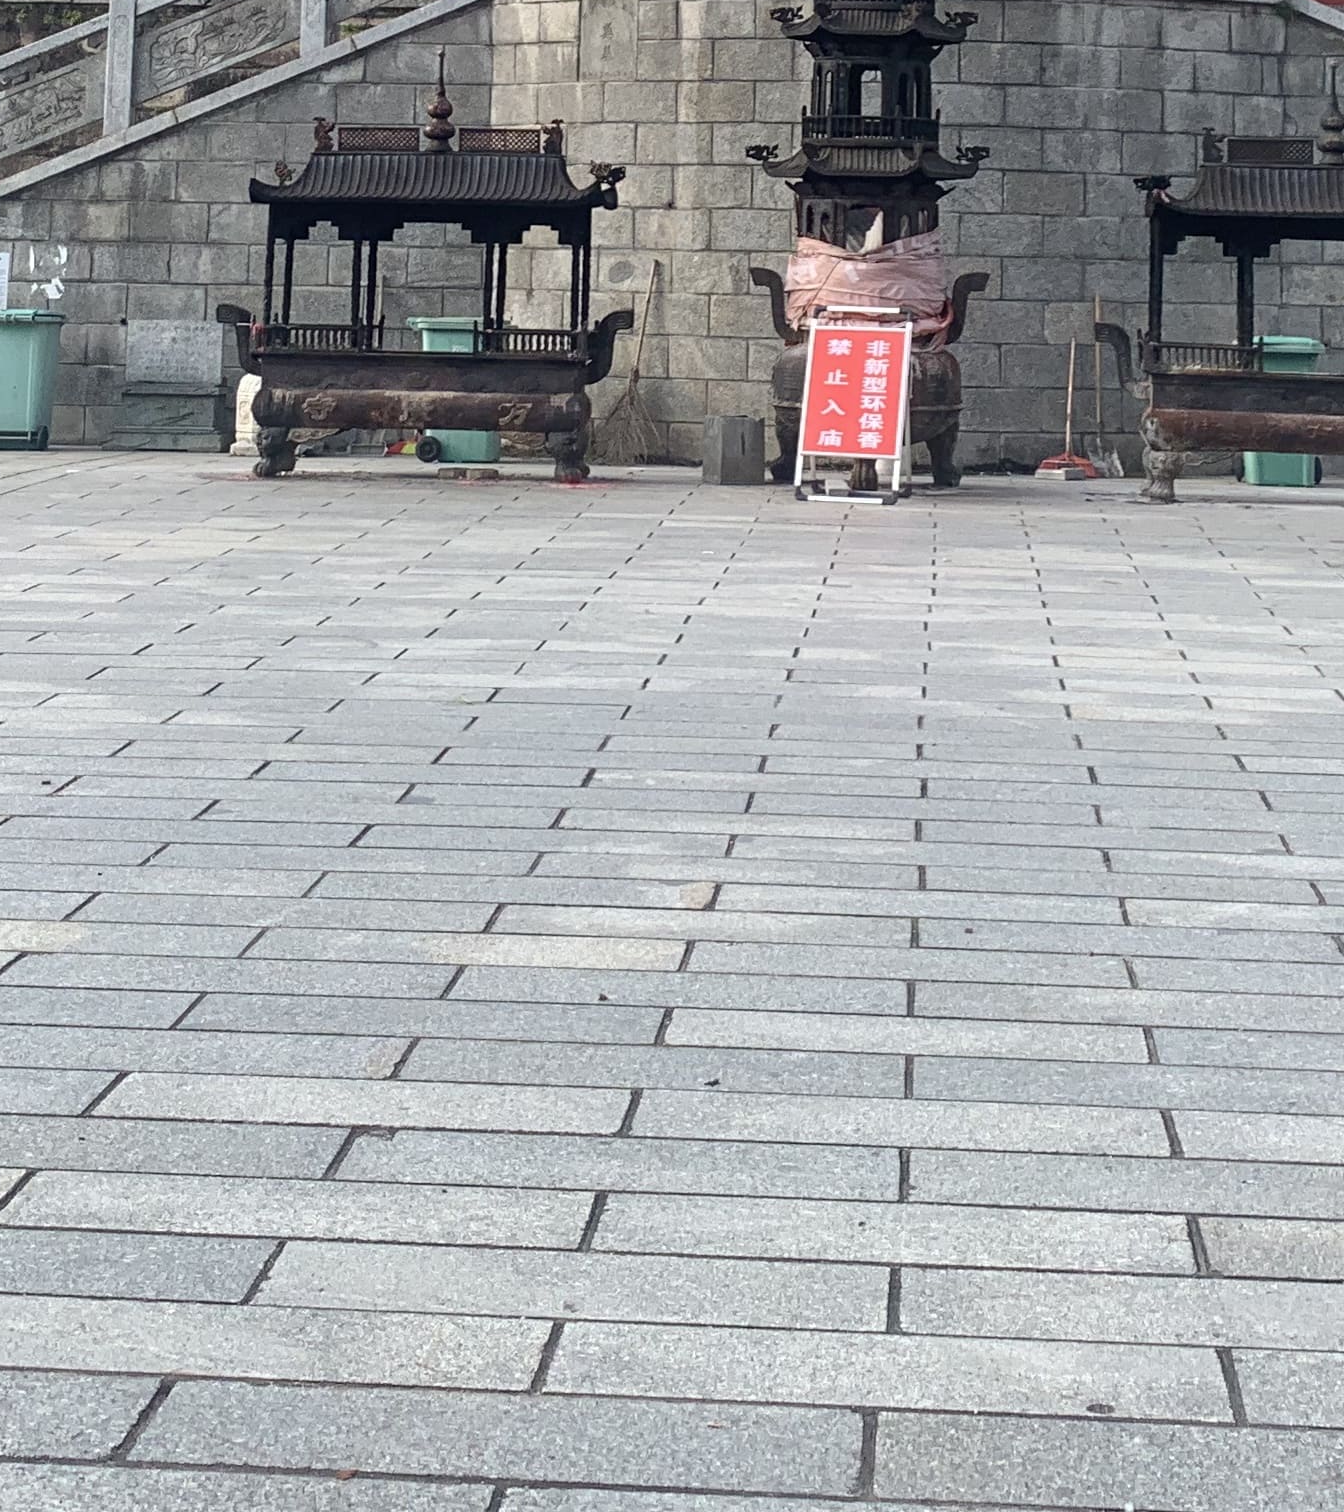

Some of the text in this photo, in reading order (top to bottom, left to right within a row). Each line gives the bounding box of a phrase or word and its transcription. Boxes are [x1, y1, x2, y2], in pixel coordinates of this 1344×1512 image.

[816, 338, 853, 448] 禁止入庙
[857, 340, 893, 450] 非新型环保香
